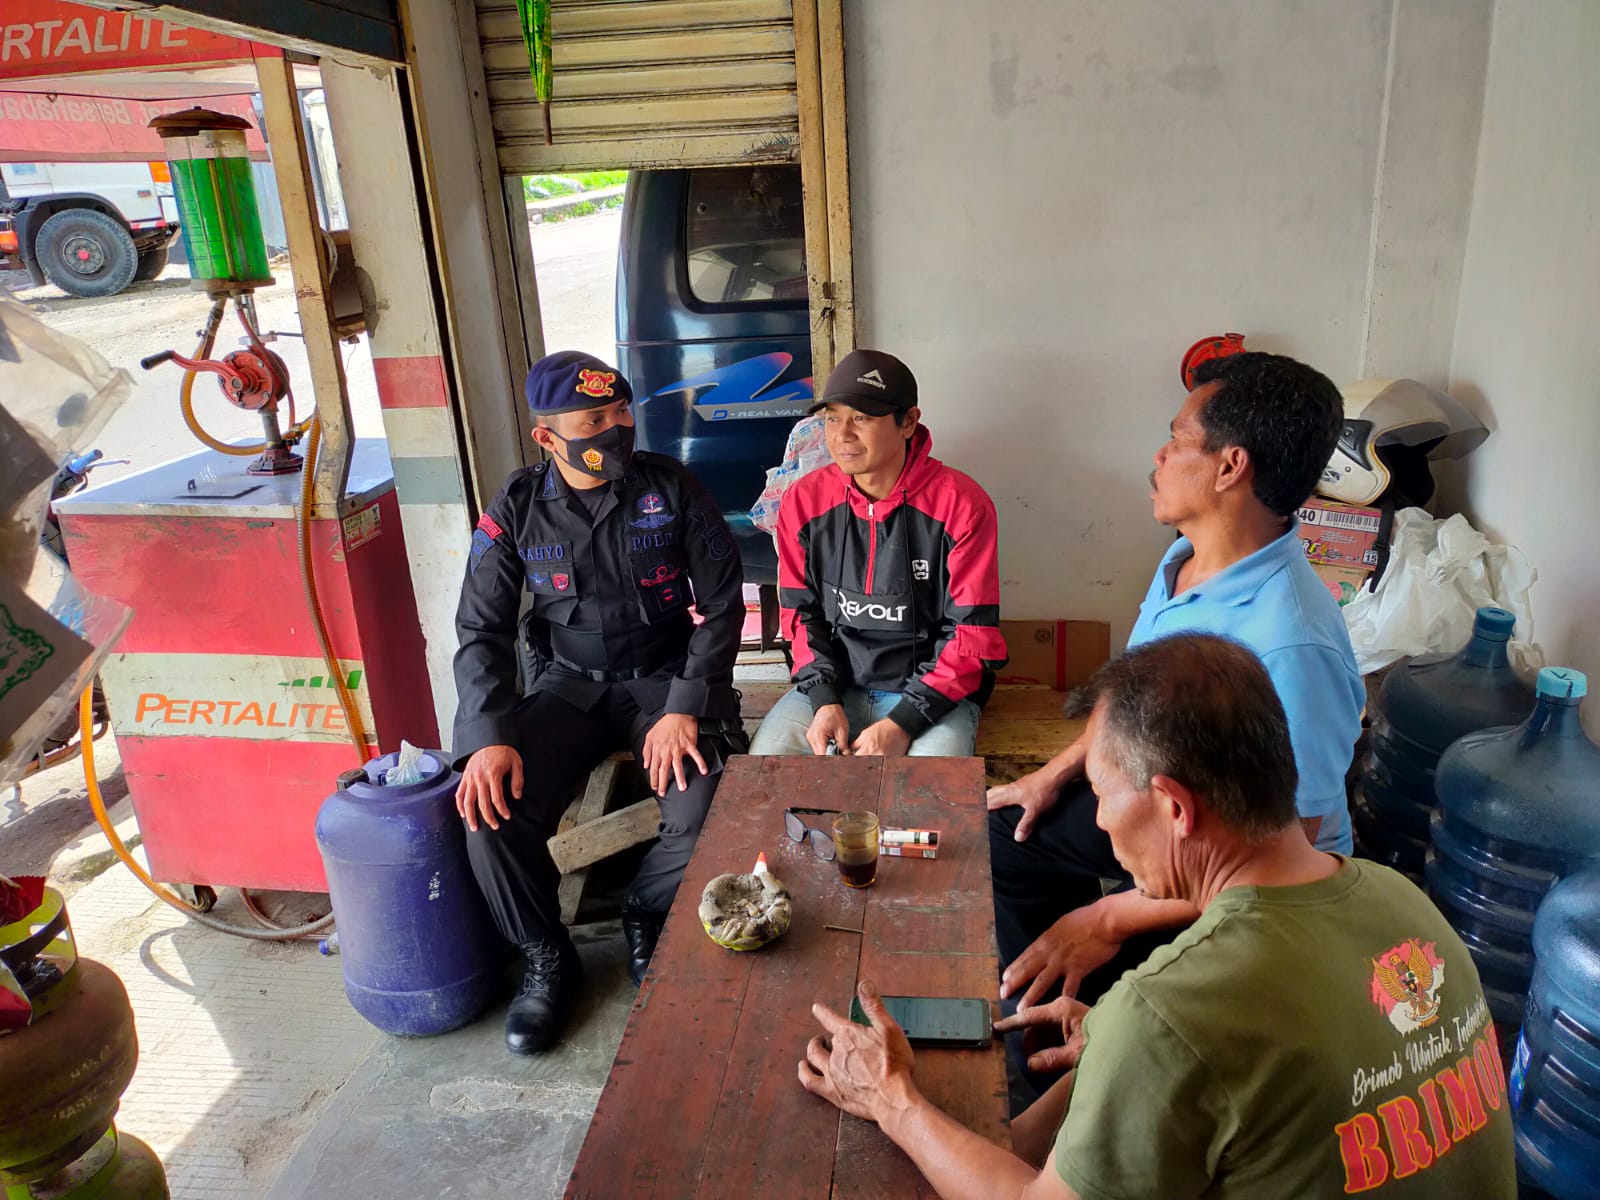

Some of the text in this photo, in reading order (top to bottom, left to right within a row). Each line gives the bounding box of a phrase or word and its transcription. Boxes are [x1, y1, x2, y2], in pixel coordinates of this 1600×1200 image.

[0, 13, 188, 62] RTALITE
[831, 588, 908, 622] REVOLT
[135, 693, 346, 729] PERTALITE
[1352, 1051, 1403, 1107] Brimob
